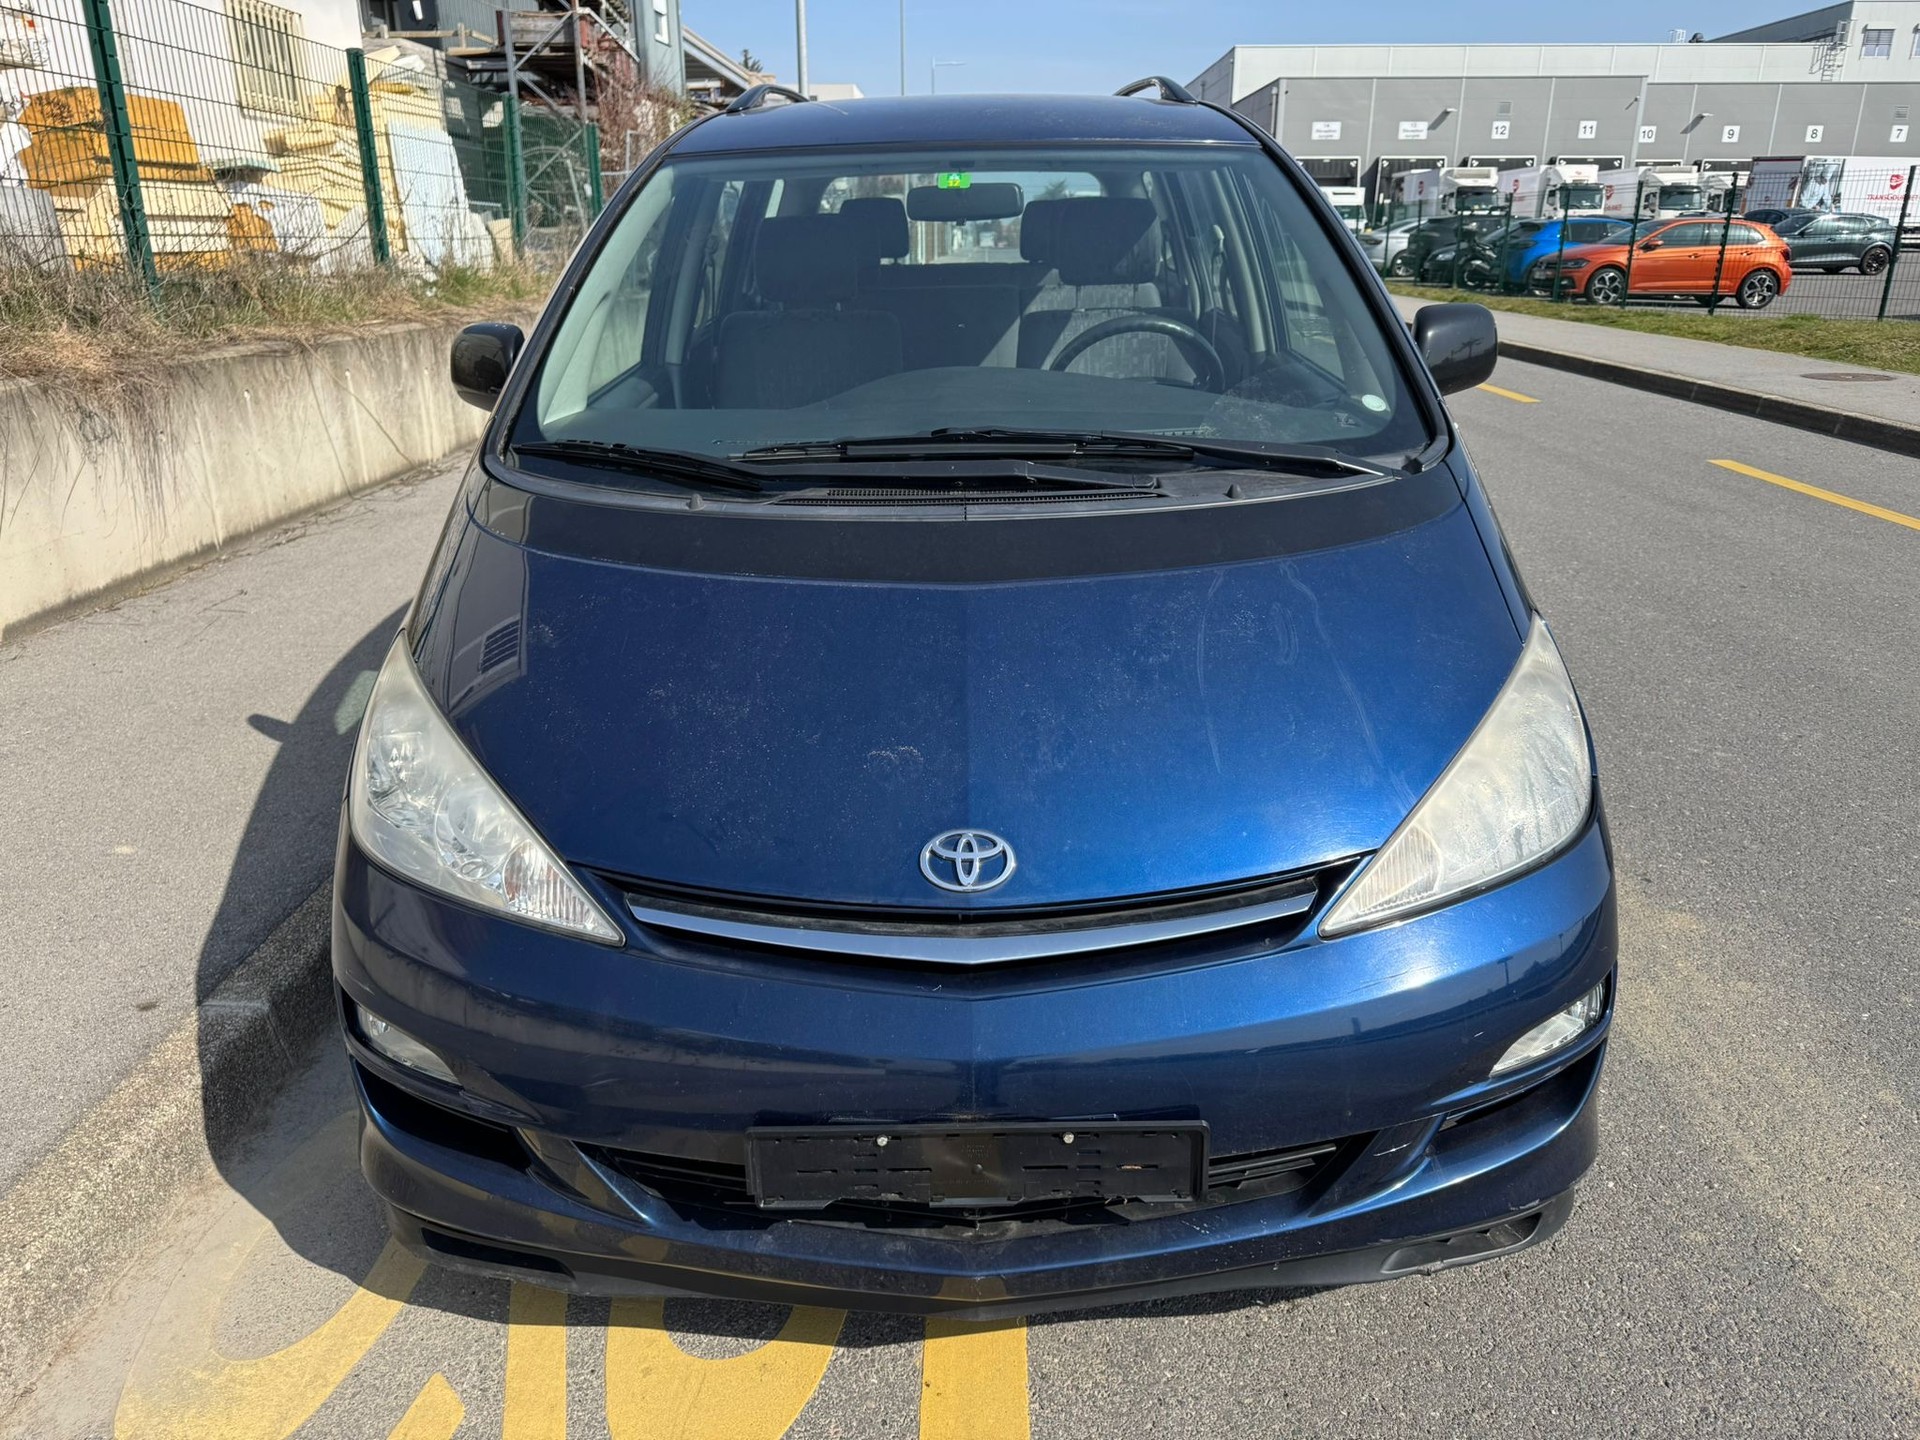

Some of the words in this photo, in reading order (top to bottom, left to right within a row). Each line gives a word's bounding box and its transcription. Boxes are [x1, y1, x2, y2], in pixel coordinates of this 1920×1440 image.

[1494, 125, 1507, 136] 12
[1582, 125, 1594, 135] 11
[1641, 129, 1654, 140] 10
[1727, 129, 1735, 139] 9
[1810, 129, 1818, 139] 8
[1895, 129, 1903, 139] 7
